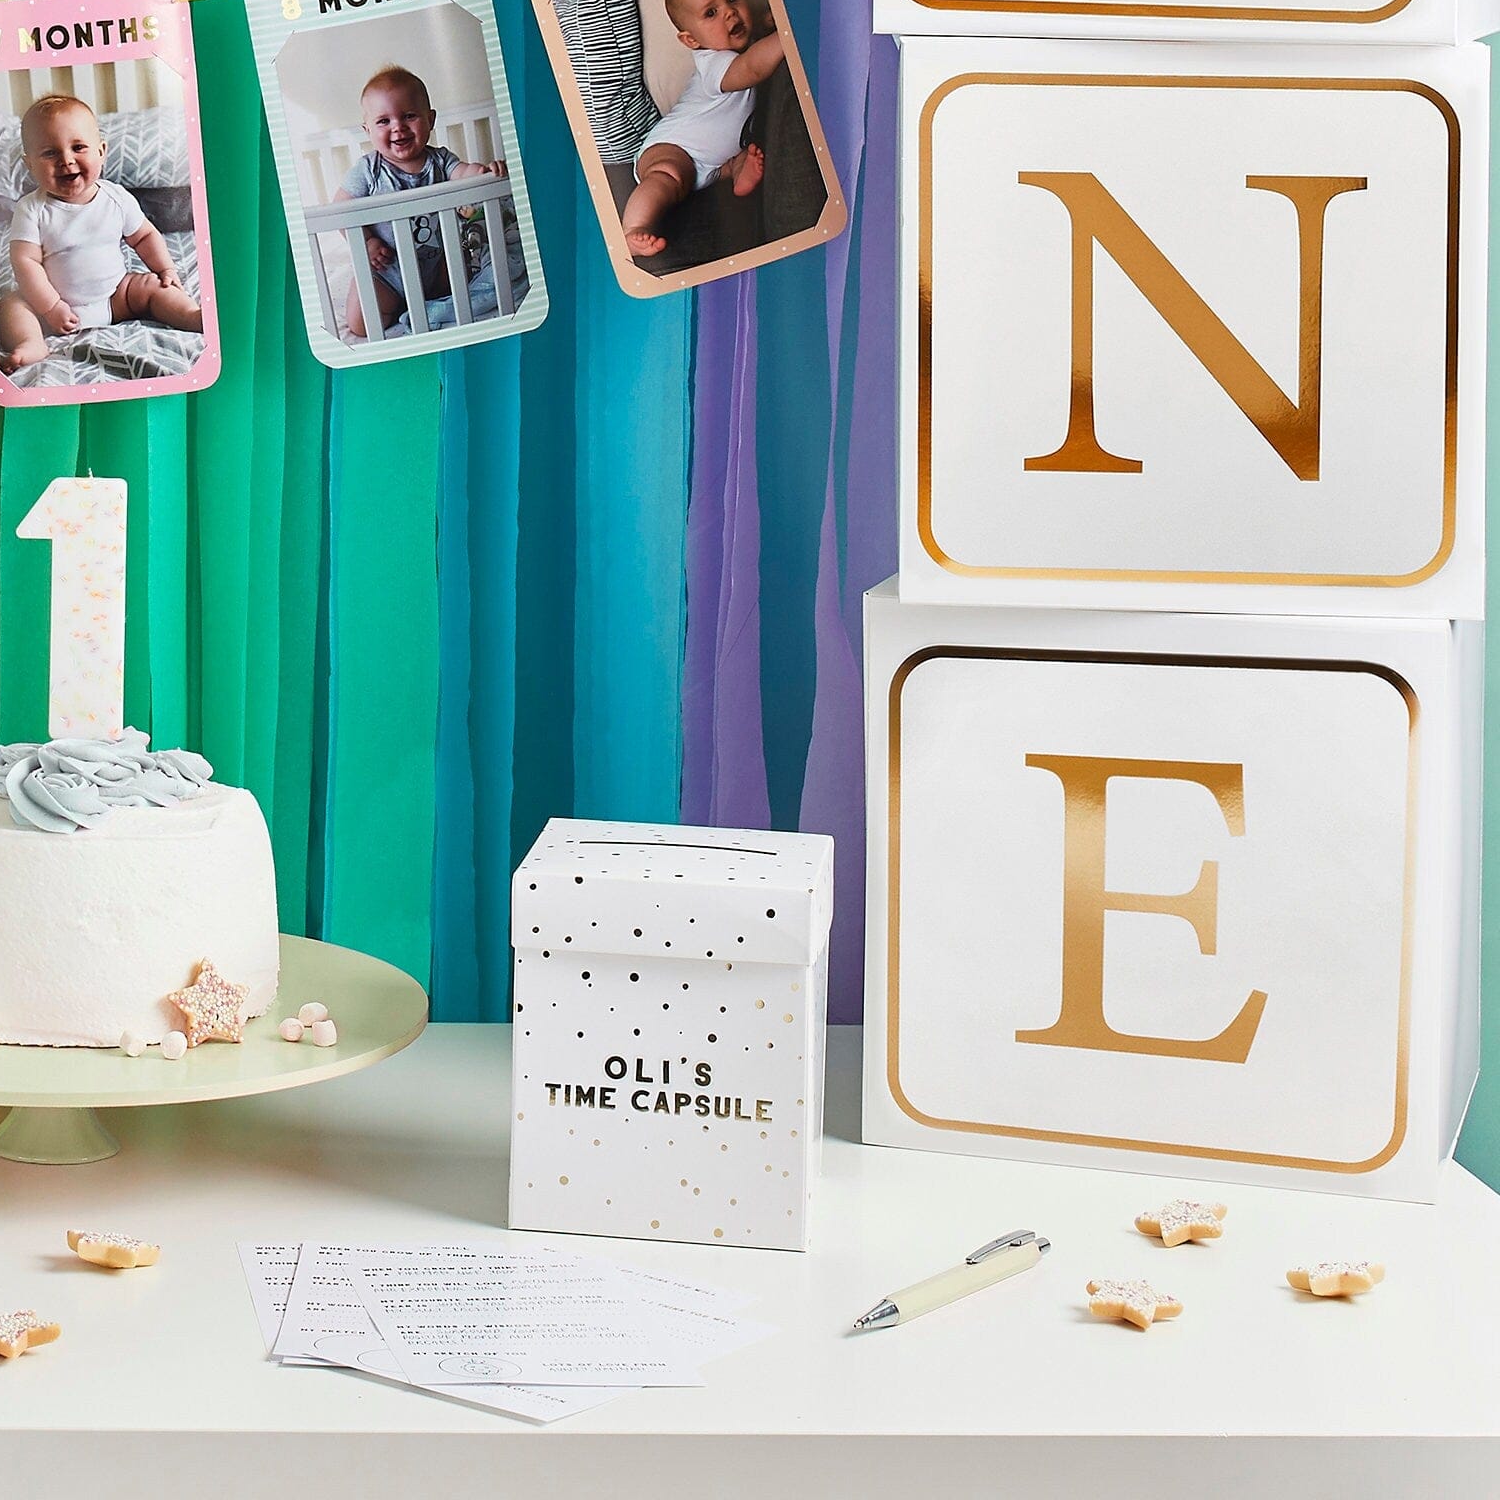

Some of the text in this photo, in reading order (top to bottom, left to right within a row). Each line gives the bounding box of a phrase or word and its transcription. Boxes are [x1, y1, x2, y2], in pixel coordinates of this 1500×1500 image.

[18, 16, 160, 54] MONTHS
[604, 1055, 713, 1087] OLI'S
[544, 1083, 774, 1123] TIME CAPSULE
